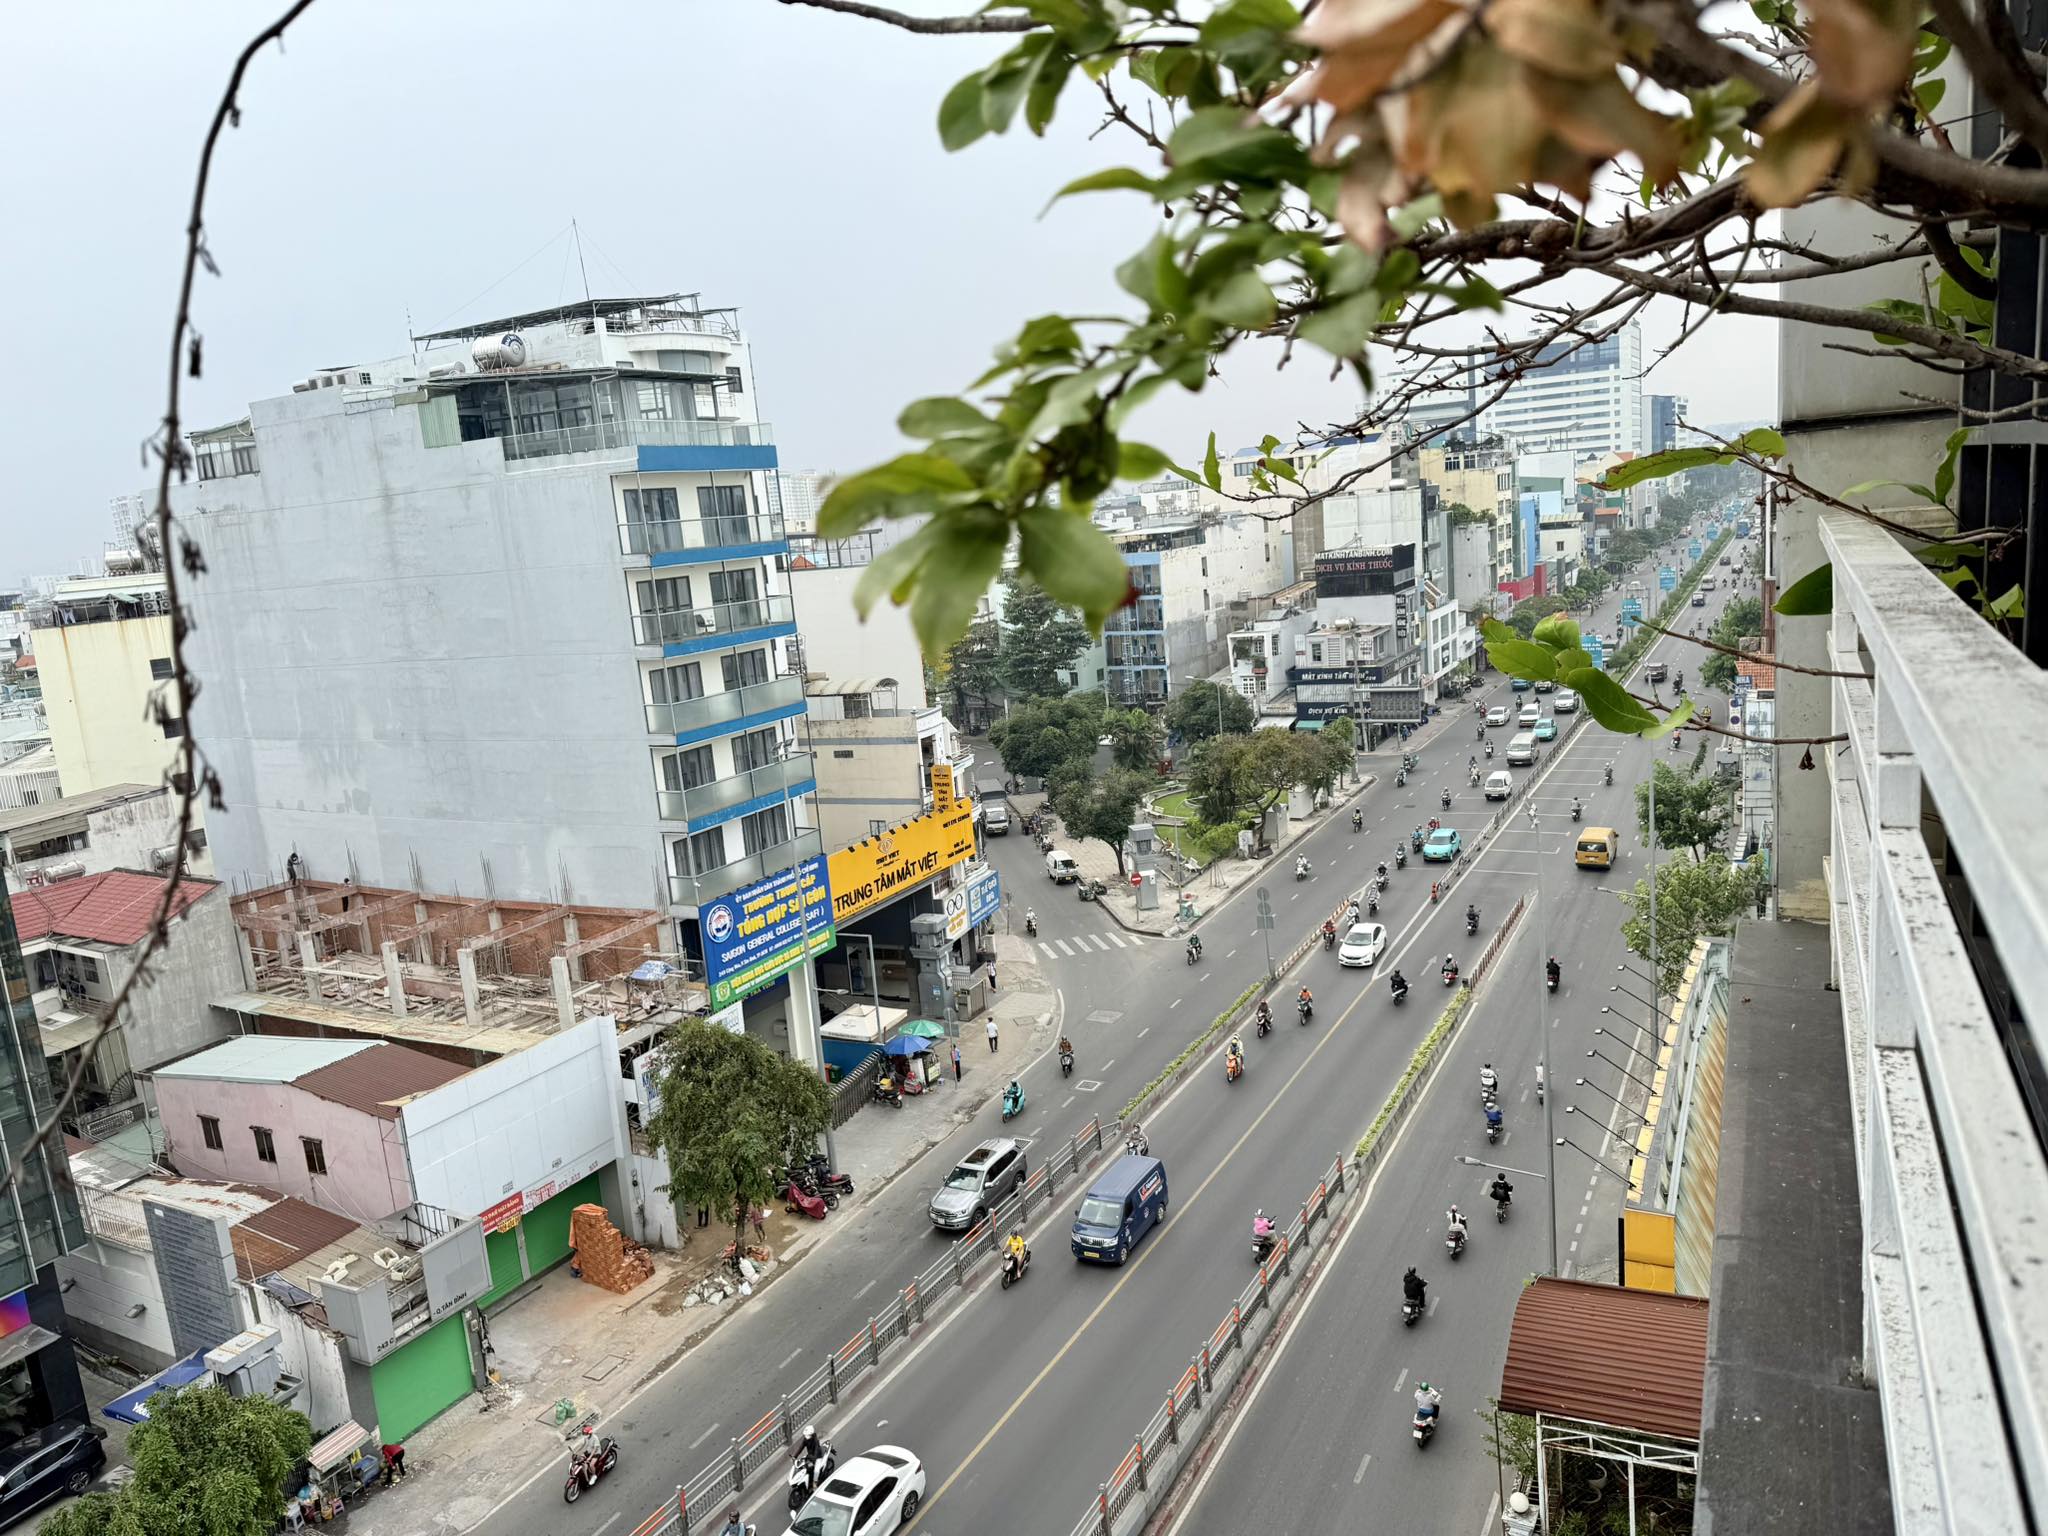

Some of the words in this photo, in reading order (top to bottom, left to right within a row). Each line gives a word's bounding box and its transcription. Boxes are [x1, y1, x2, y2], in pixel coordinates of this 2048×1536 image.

[1316, 563, 1333, 574] DỊCH
[1336, 563, 1345, 573] VỤ
[1347, 560, 1366, 571] KÍNH
[1369, 557, 1393, 569] THUỐC
[800, 872, 816, 889] CẤP
[834, 883, 873, 912] TRUNG
[874, 872, 896, 893] TÂM
[896, 859, 917, 882] MẮT
[918, 851, 938, 872] VIỆT
[736, 912, 765, 938] TỔNG
[766, 903, 788, 925] HỢP
[806, 885, 826, 906] GÒN
[721, 945, 745, 963] SAIGON
[747, 930, 775, 950] GENERAL
[775, 917, 801, 936] COLLEGE
